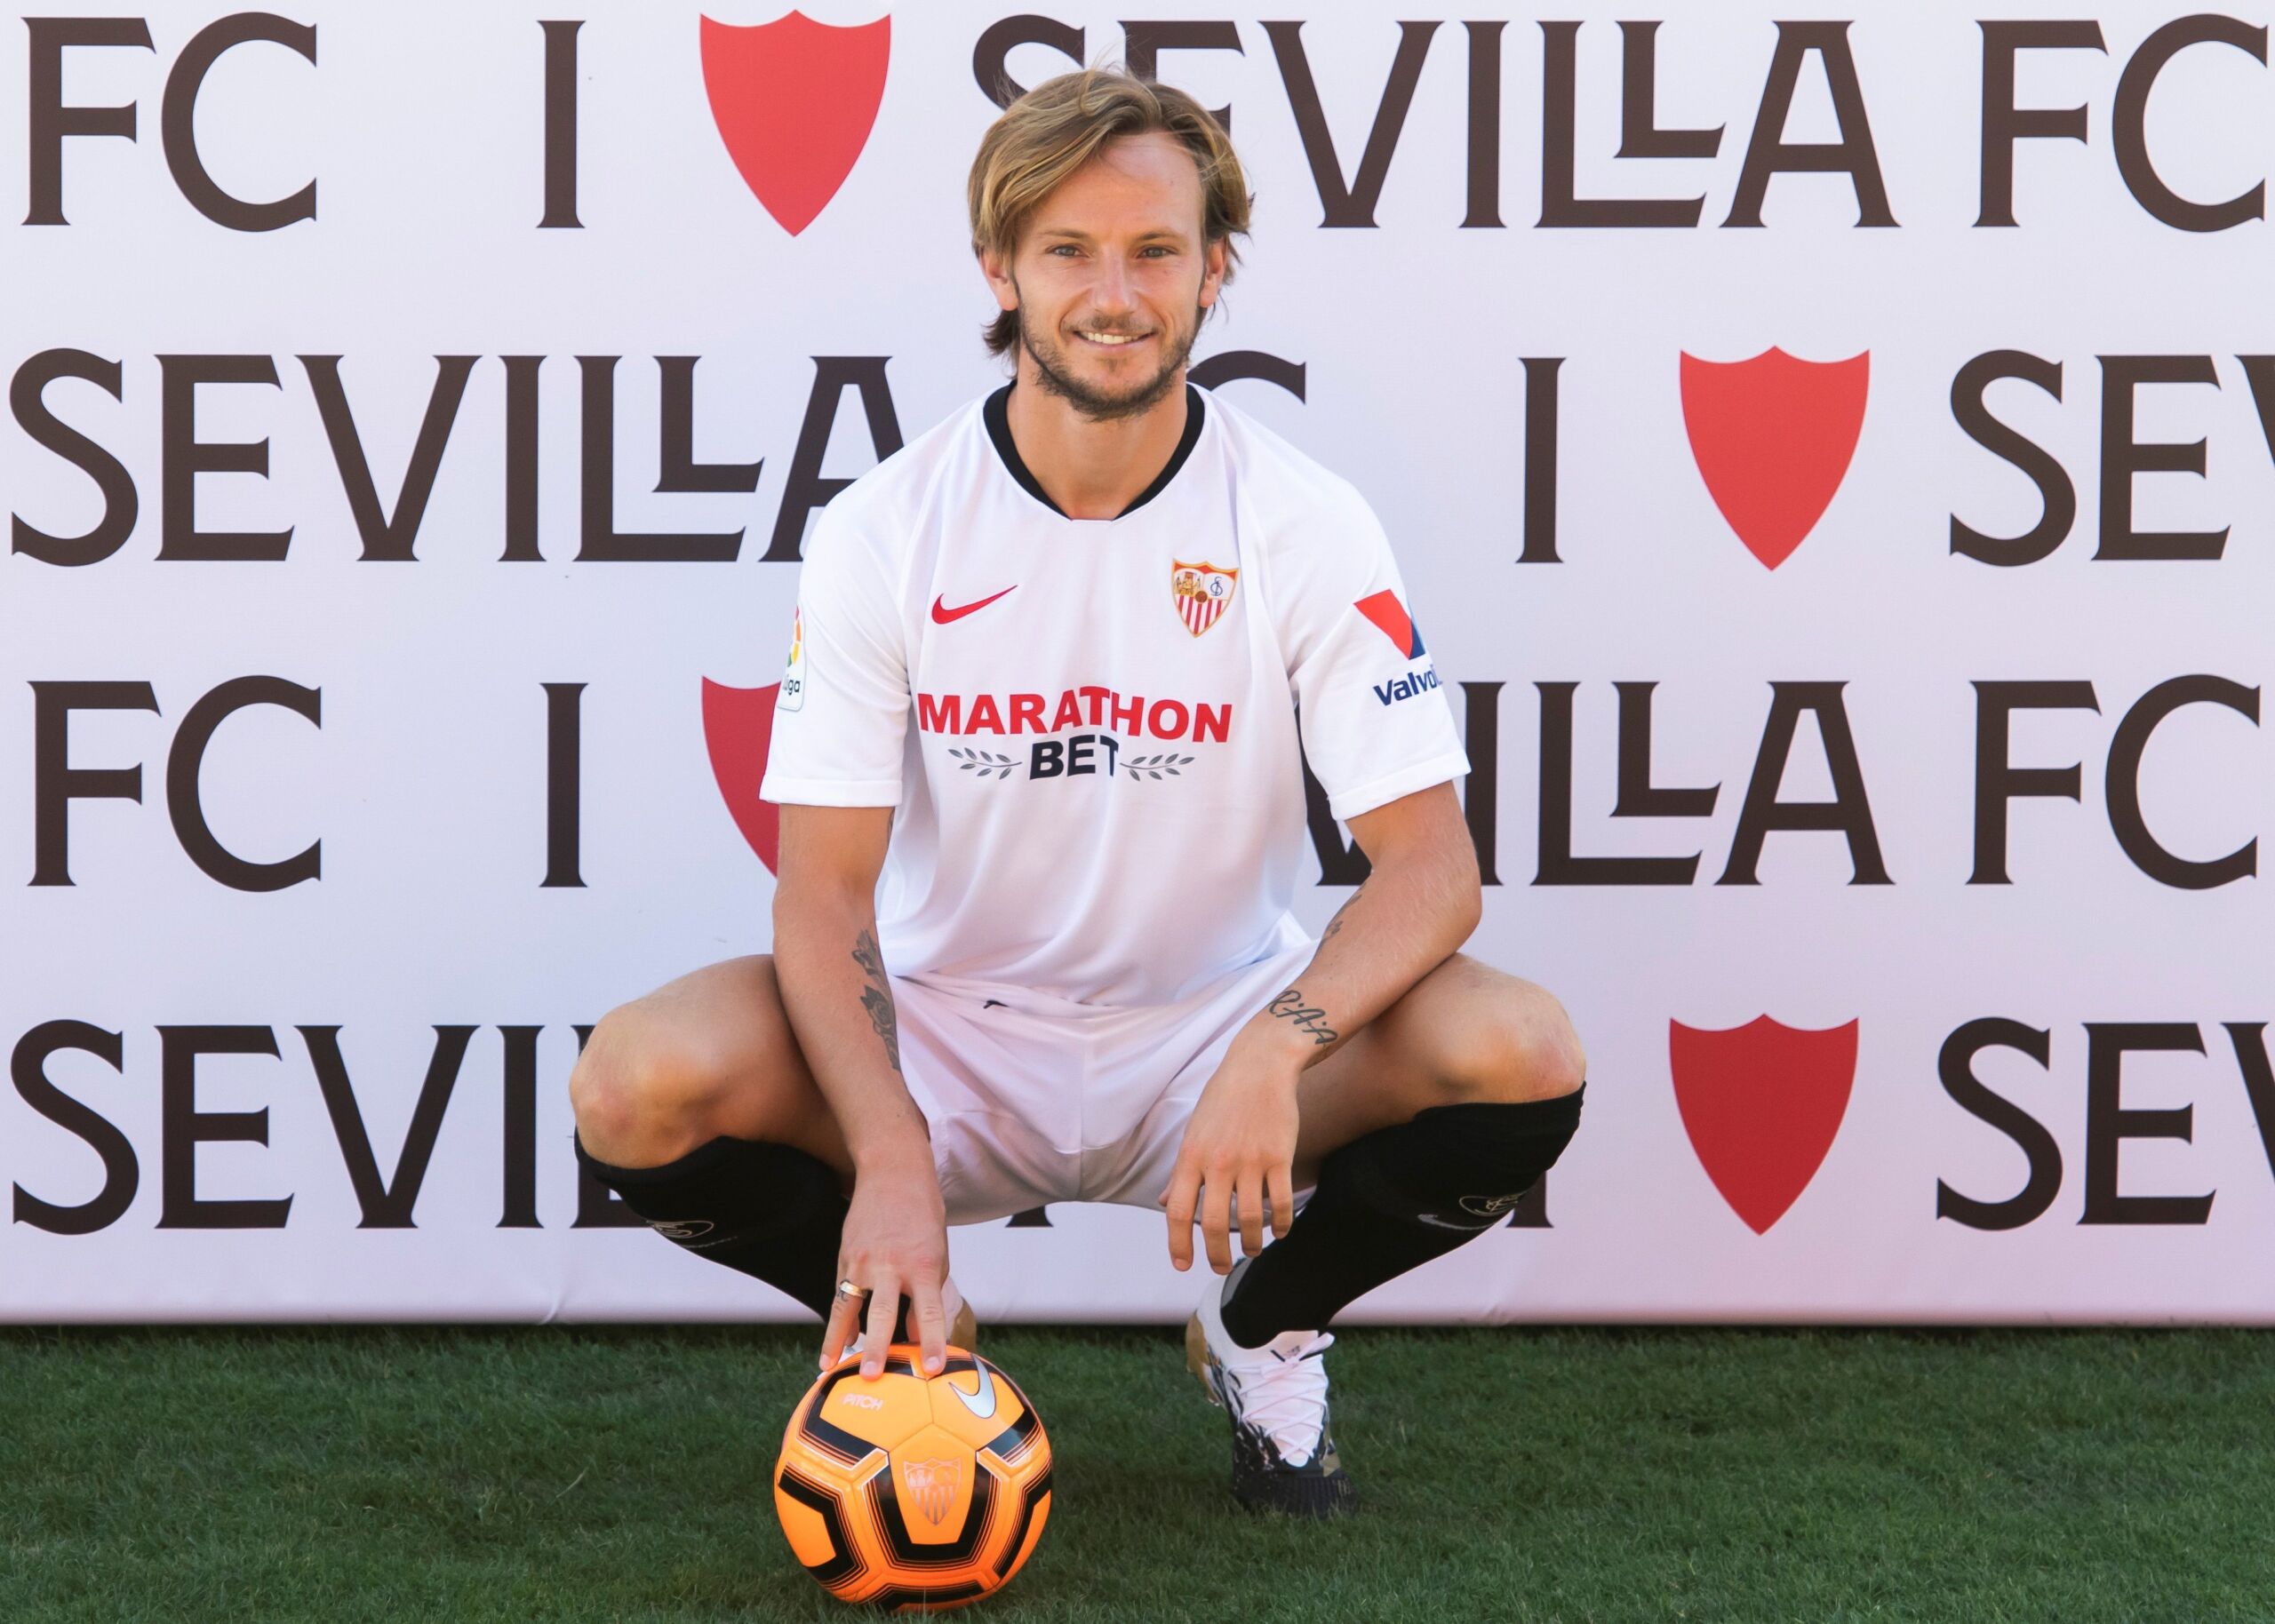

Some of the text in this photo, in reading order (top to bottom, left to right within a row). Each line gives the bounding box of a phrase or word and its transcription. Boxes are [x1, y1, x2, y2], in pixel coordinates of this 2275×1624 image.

[21, 12, 317, 233] FC
[536, 20, 587, 228] I
[1972, 13, 2268, 233] FC
[1514, 357, 1567, 563] I
[27, 674, 322, 893] FC
[539, 682, 589, 888] I
[1966, 673, 2261, 890] FC
[917, 685, 1233, 743] MARATHON
[1029, 734, 1119, 781] BET
